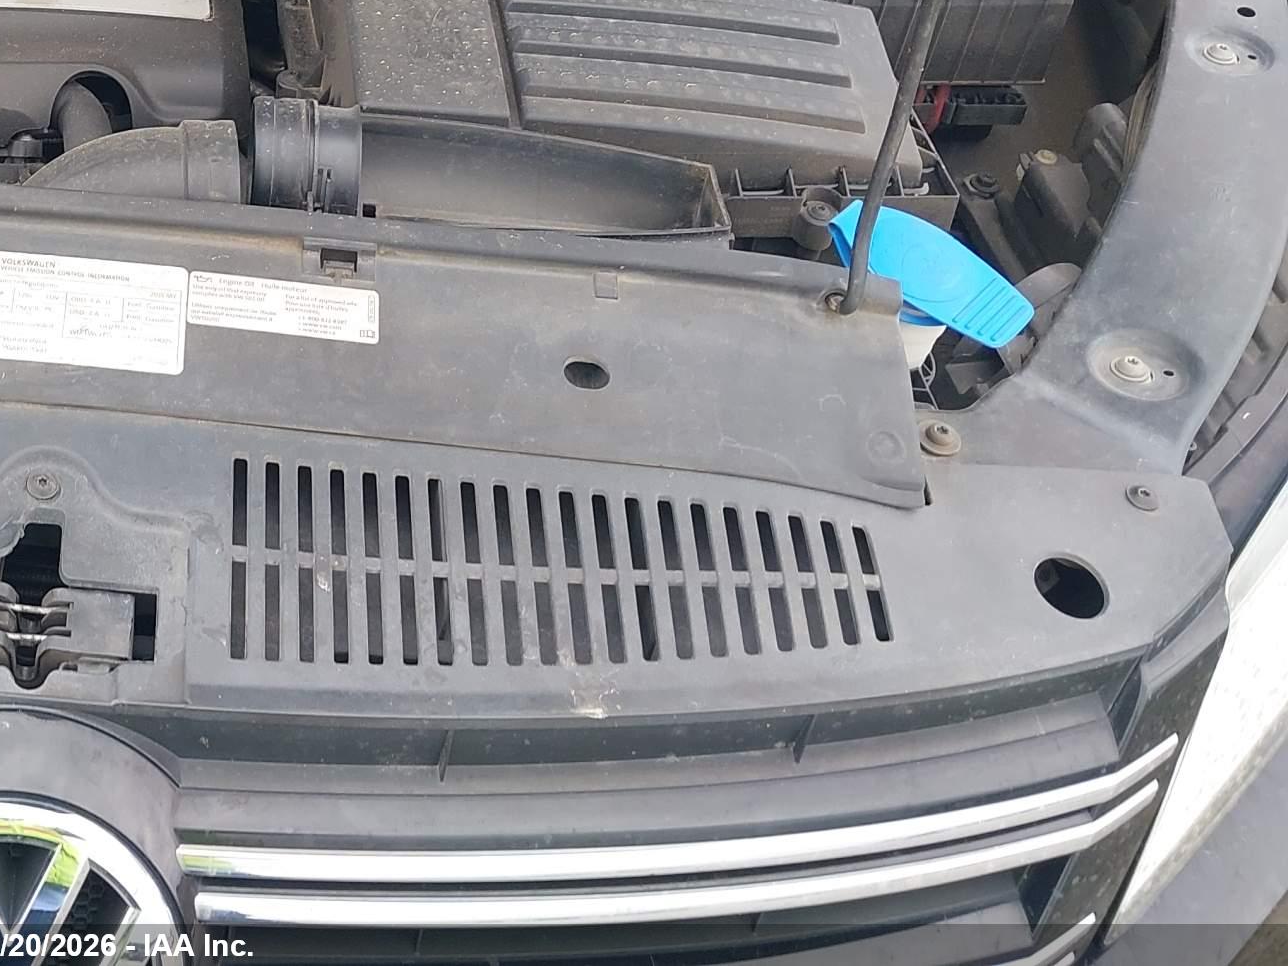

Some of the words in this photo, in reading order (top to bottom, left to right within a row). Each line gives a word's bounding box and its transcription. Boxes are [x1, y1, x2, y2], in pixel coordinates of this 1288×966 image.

[2, 257, 55, 268] VOLKSWAGEN
[27, 267, 55, 275] EMISSION
[219, 277, 242, 286] Engine
[282, 284, 308, 293] moteur
